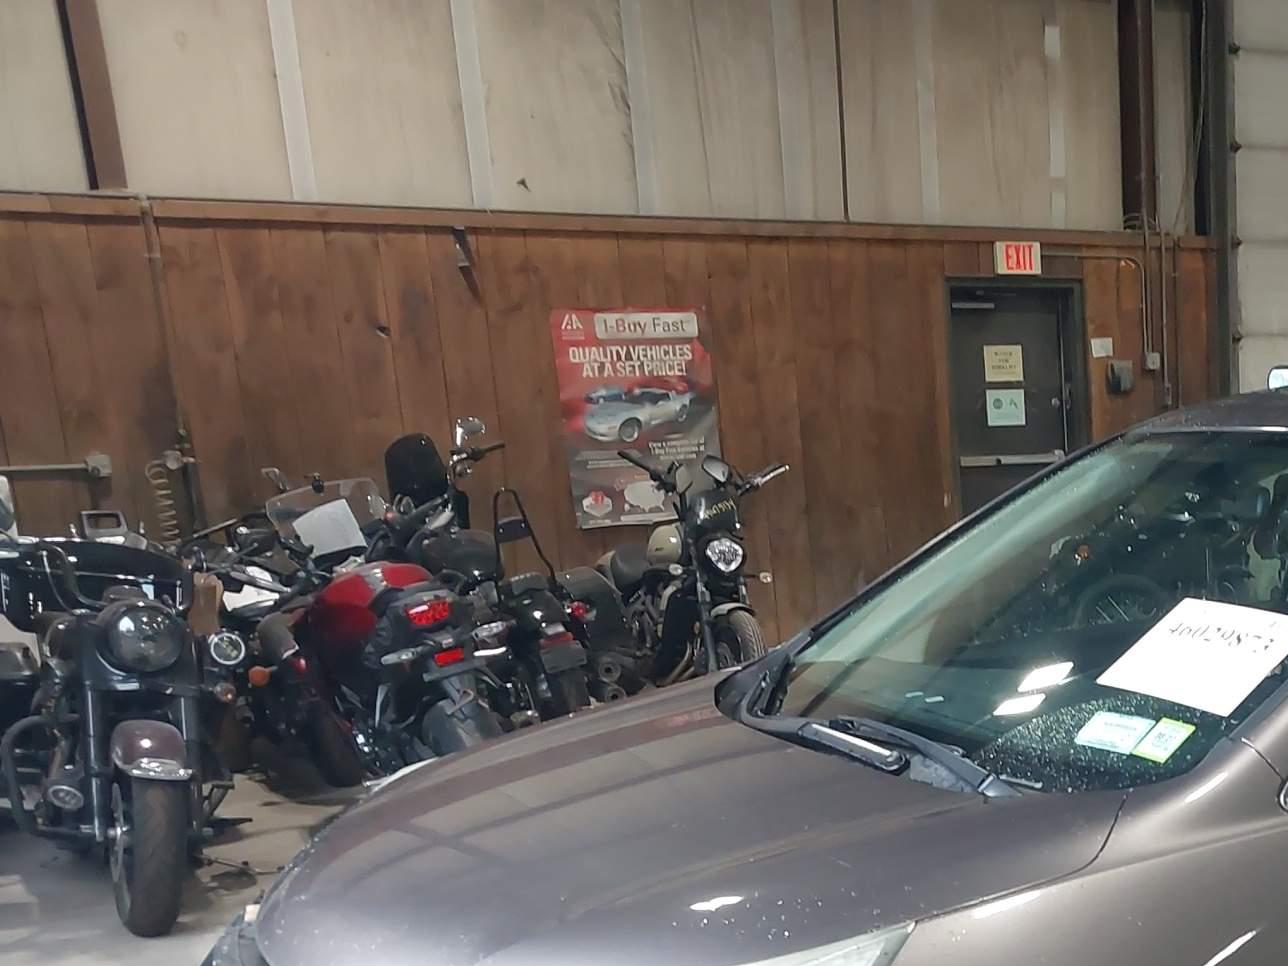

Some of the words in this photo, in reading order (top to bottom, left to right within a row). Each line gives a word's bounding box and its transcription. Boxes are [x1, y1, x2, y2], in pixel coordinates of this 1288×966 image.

[1005, 244, 1033, 270] EXIT
[603, 318, 647, 335] I-Buy
[653, 317, 686, 333] Fast
[569, 346, 629, 363] QUALITY
[630, 344, 692, 361] VEHICLES
[582, 362, 600, 378] AT
[604, 362, 614, 377] A
[616, 361, 641, 377] SET
[644, 360, 687, 376] PRICE!
